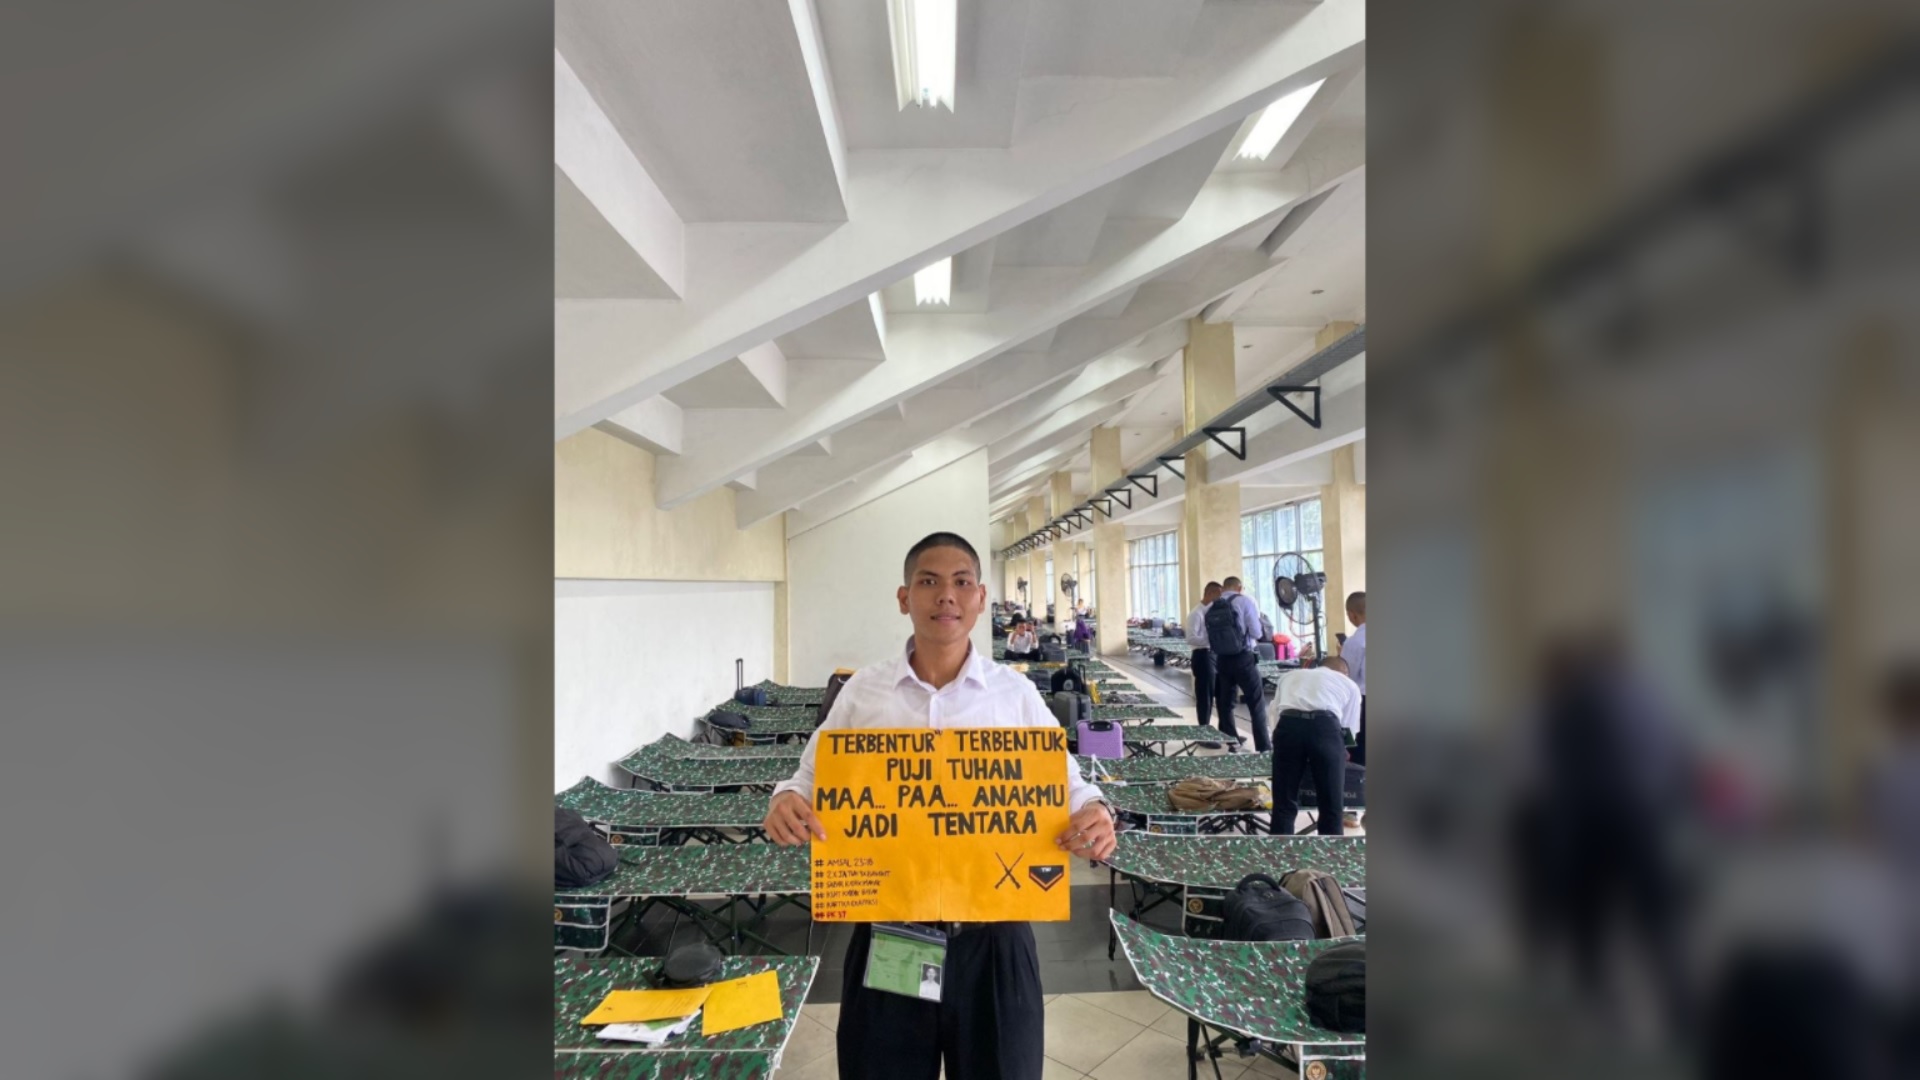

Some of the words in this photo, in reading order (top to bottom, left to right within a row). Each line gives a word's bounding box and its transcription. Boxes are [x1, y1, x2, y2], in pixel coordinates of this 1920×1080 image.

[954, 730, 1064, 753] TERBENTUK
[887, 759, 932, 781] PUJI
[946, 759, 1022, 781] TUHAN
[973, 784, 1064, 808] ANAKMU
[844, 814, 898, 838] JADI
[927, 810, 1037, 836] TENTARA
